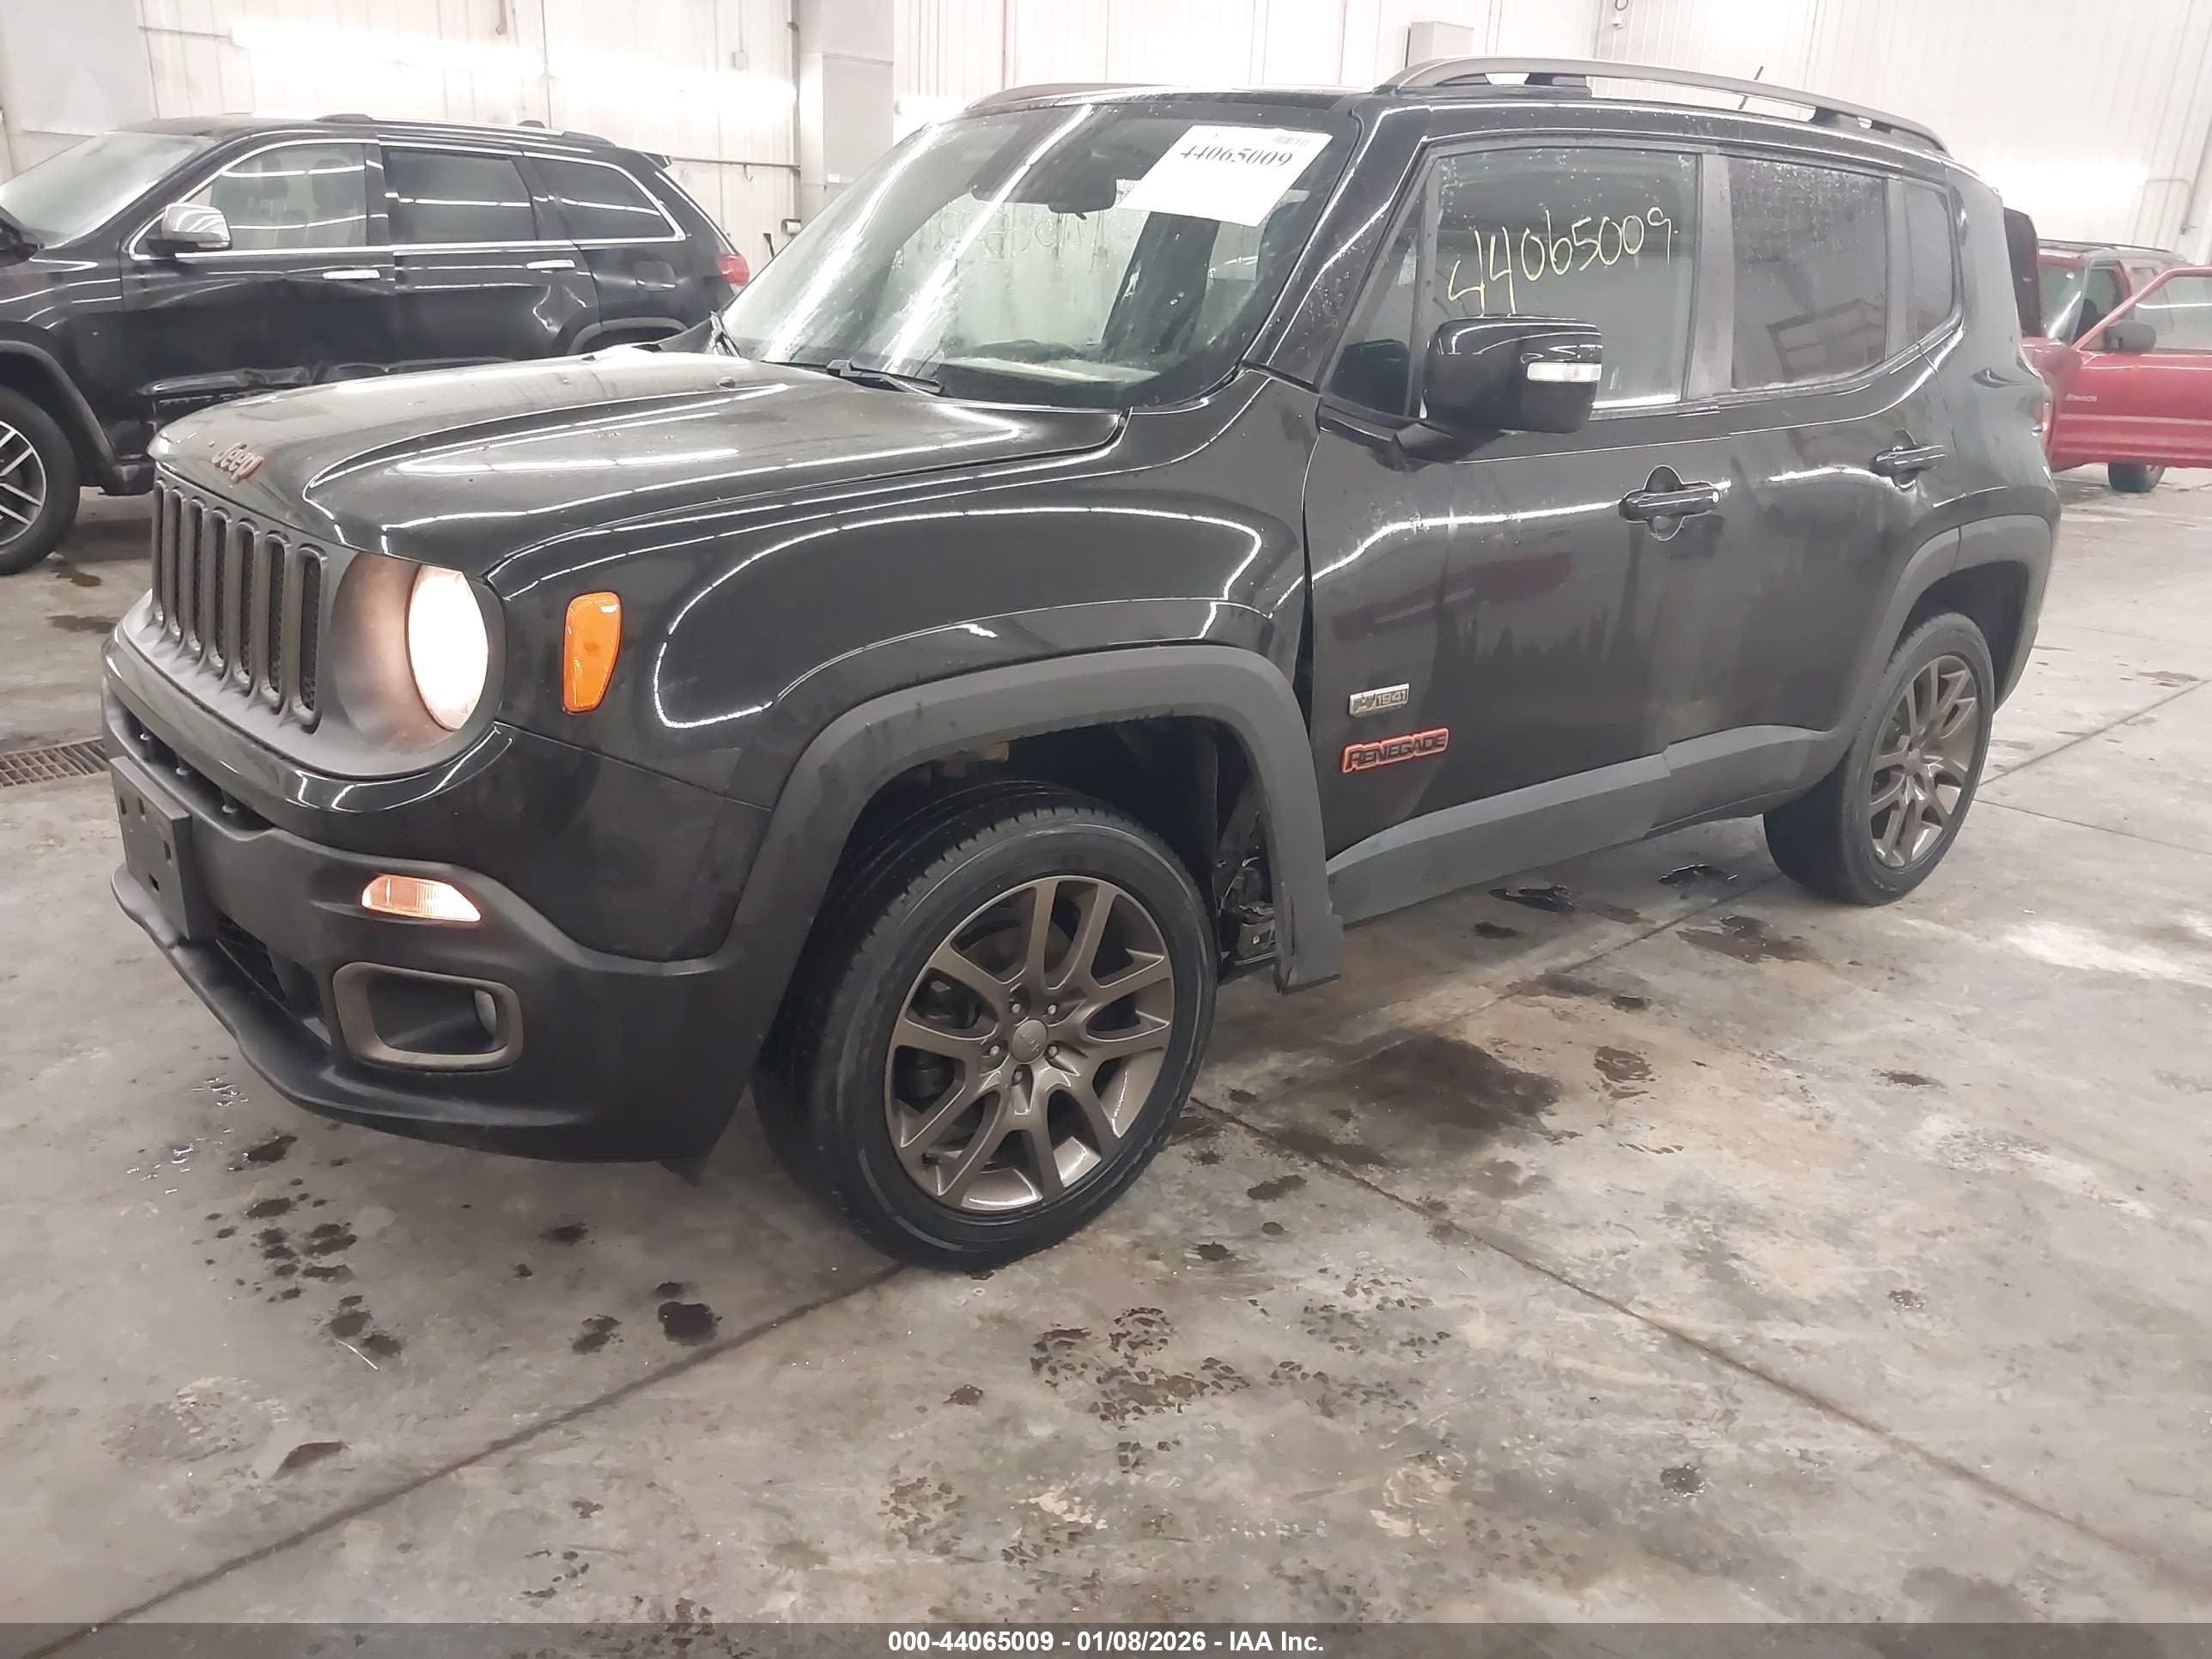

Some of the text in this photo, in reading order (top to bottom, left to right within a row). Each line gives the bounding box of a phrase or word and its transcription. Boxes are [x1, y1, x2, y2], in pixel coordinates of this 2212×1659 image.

[1180, 144, 1293, 167] 44065009
[1448, 206, 1671, 317] 44065009
[211, 441, 264, 483] Jeep
[1376, 690, 1407, 706] 1941
[1344, 729, 1448, 770] RENEGADE
